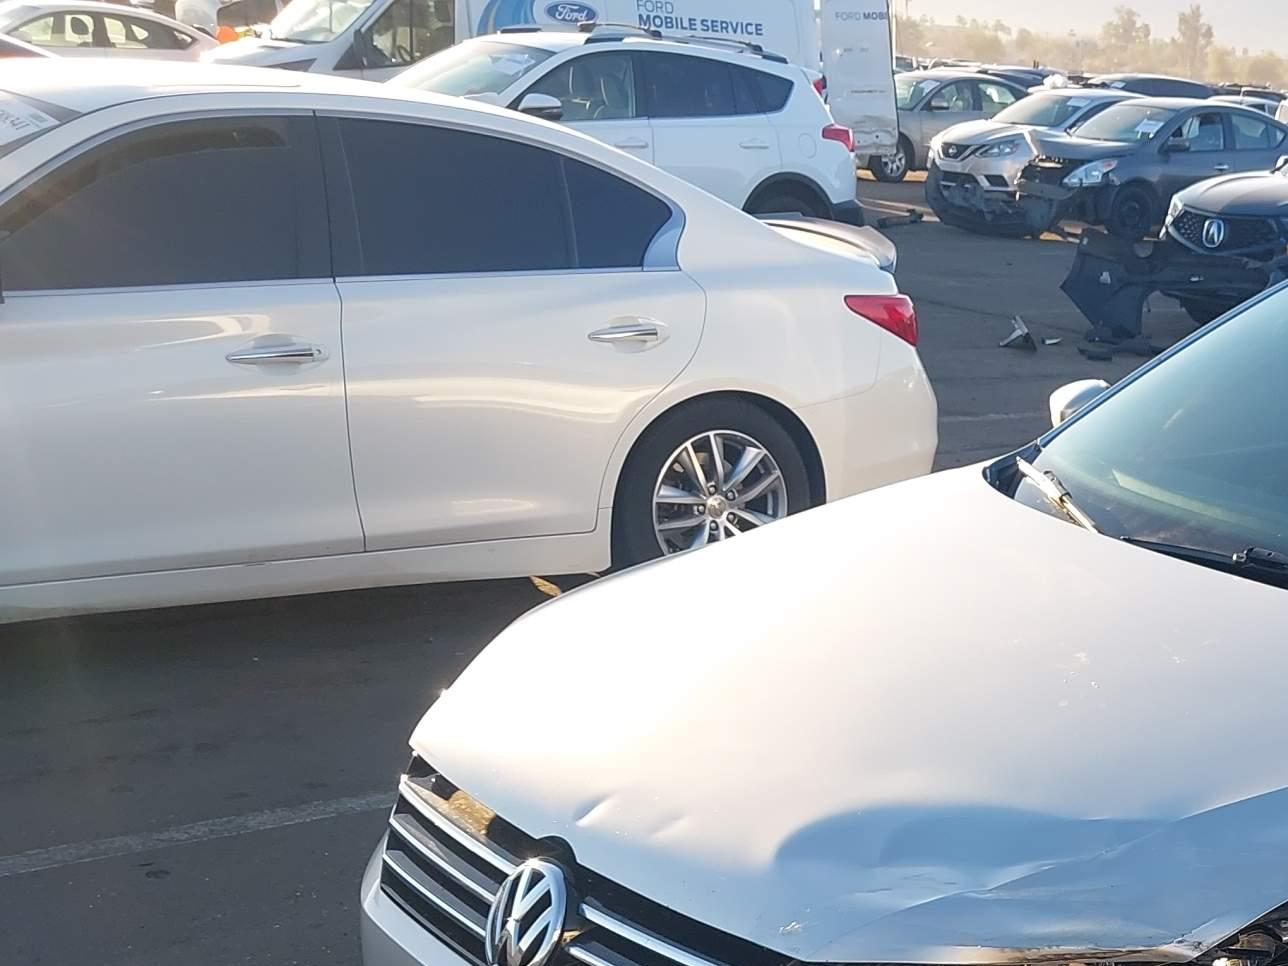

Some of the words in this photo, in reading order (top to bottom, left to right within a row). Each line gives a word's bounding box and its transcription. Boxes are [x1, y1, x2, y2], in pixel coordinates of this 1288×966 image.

[555, 3, 590, 21] Ford
[637, 0, 674, 14] FORD
[638, 14, 697, 31] MOBILE
[700, 19, 764, 36] SERVICE
